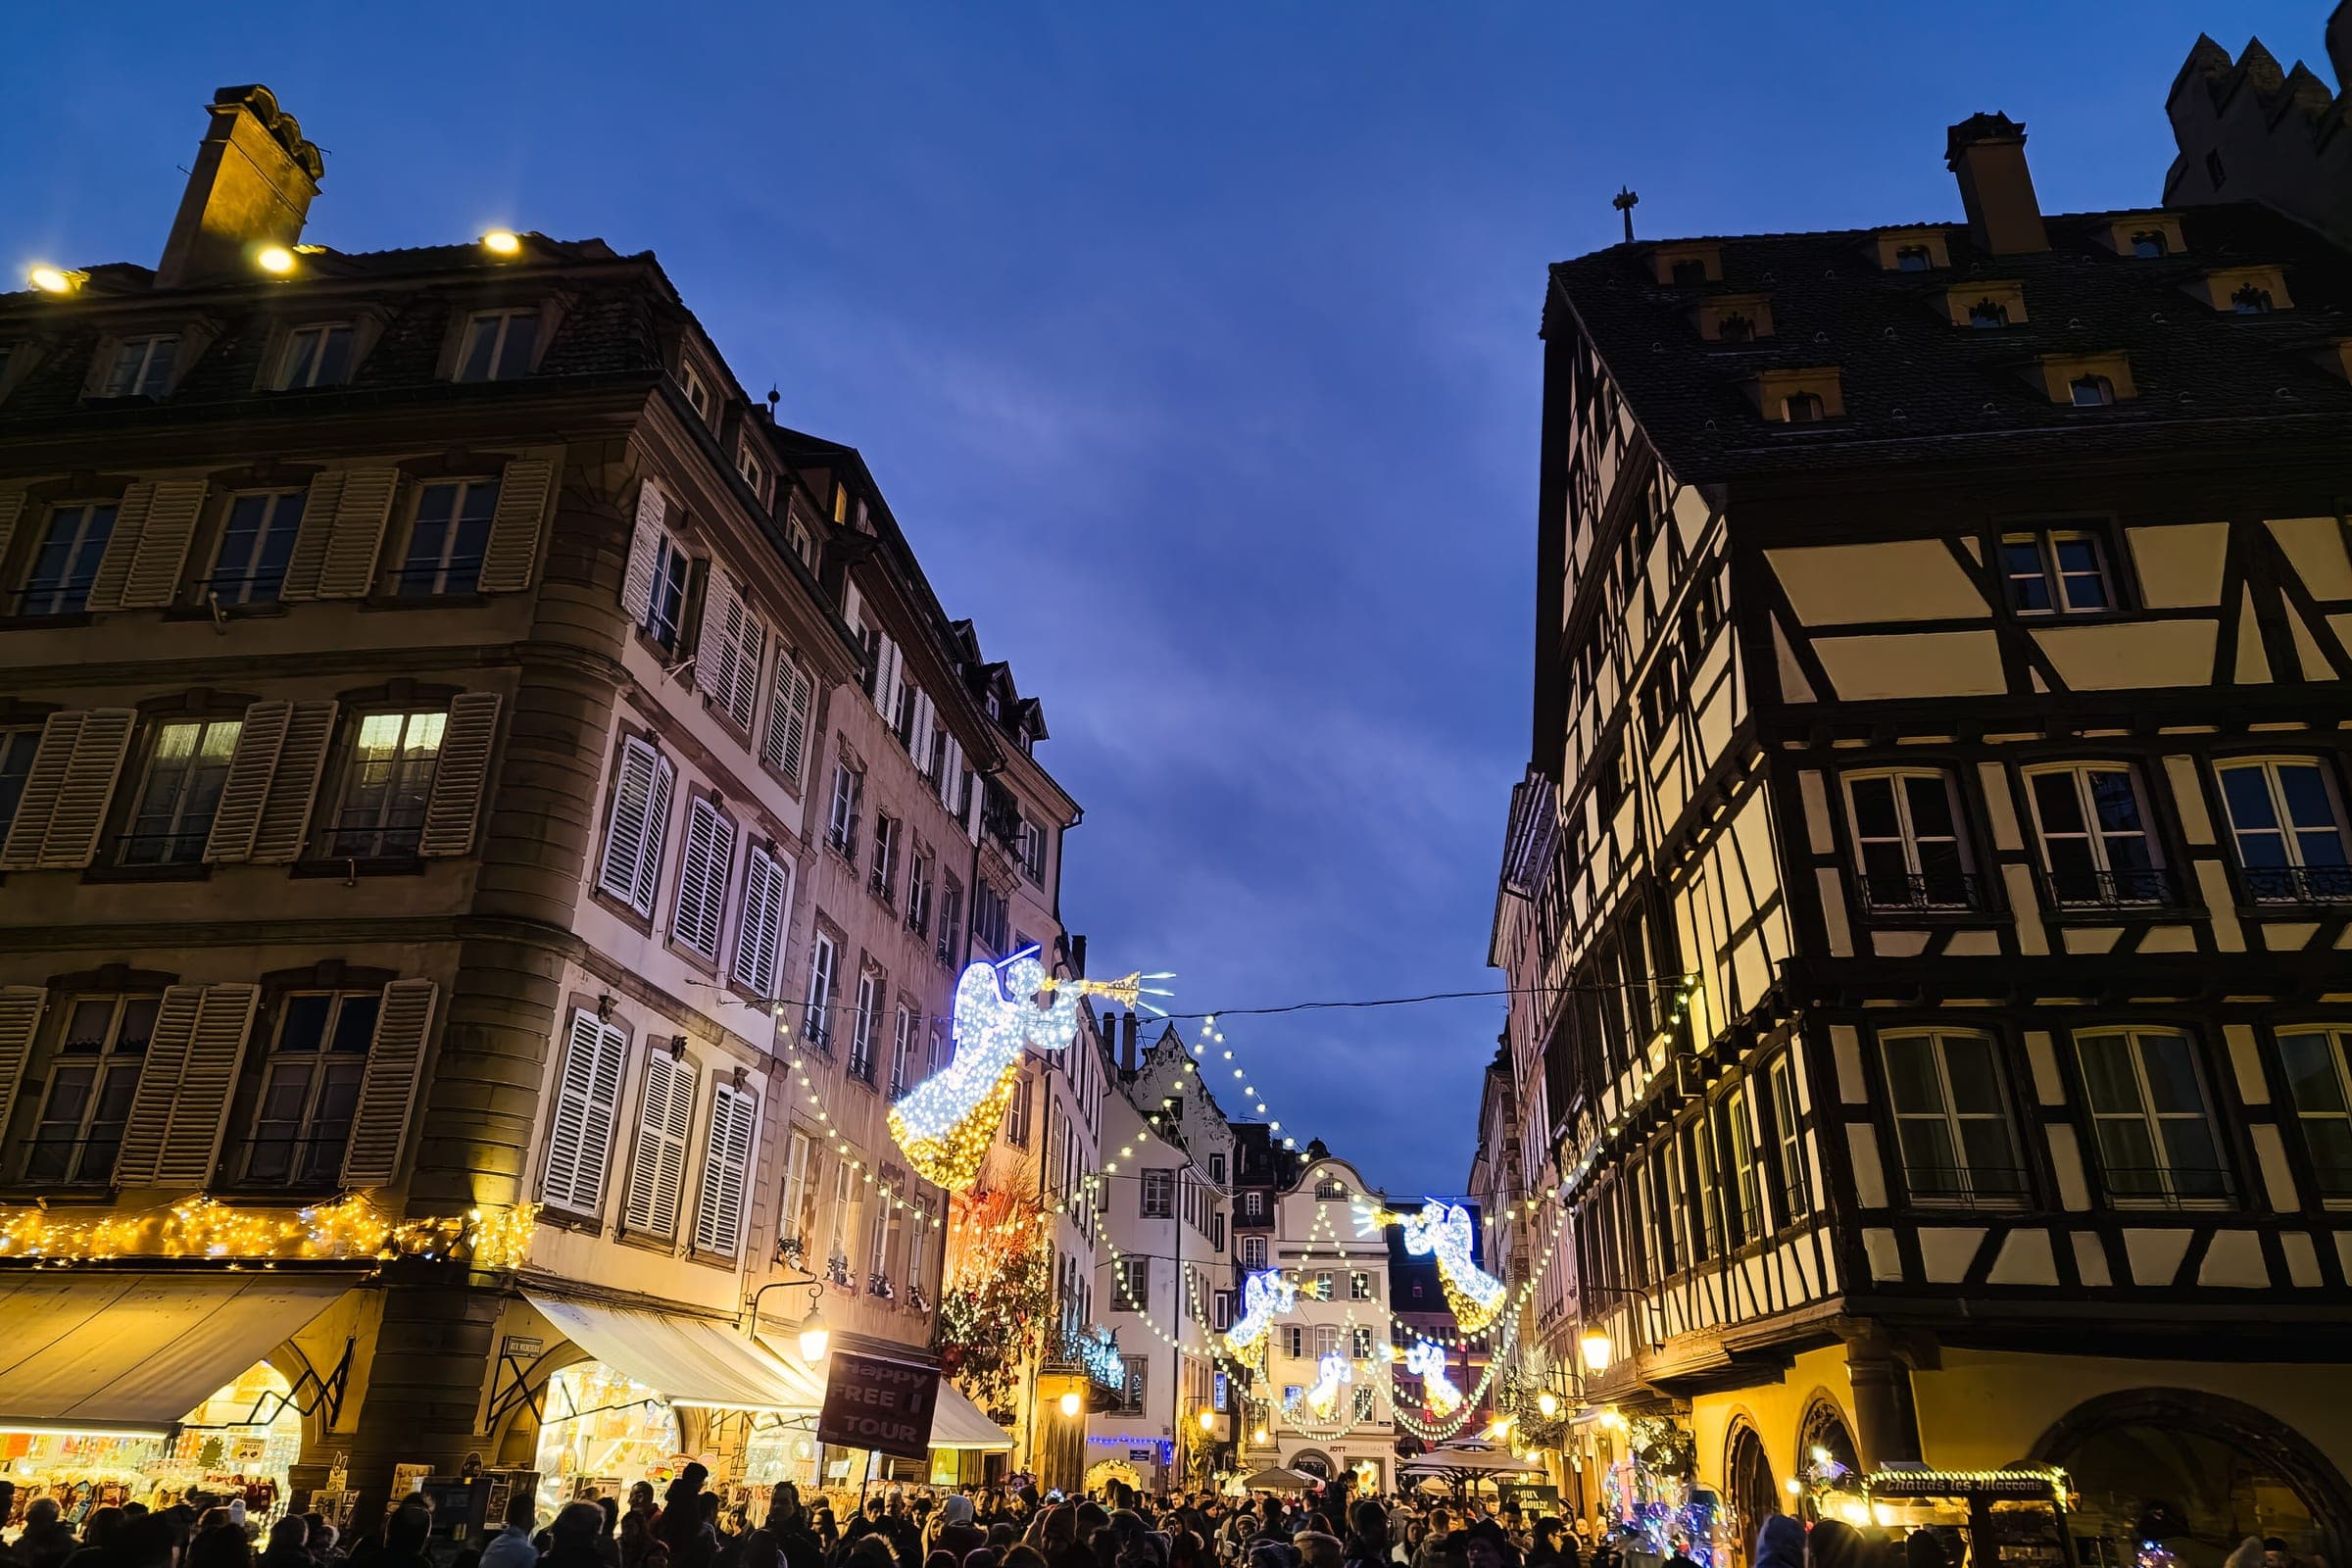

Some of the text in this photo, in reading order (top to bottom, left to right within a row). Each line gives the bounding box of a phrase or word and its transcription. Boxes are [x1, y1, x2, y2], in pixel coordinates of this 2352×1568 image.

[838, 1358, 928, 1389] Happy
[829, 1382, 897, 1407] FREE
[844, 1415, 918, 1443] TOUR
